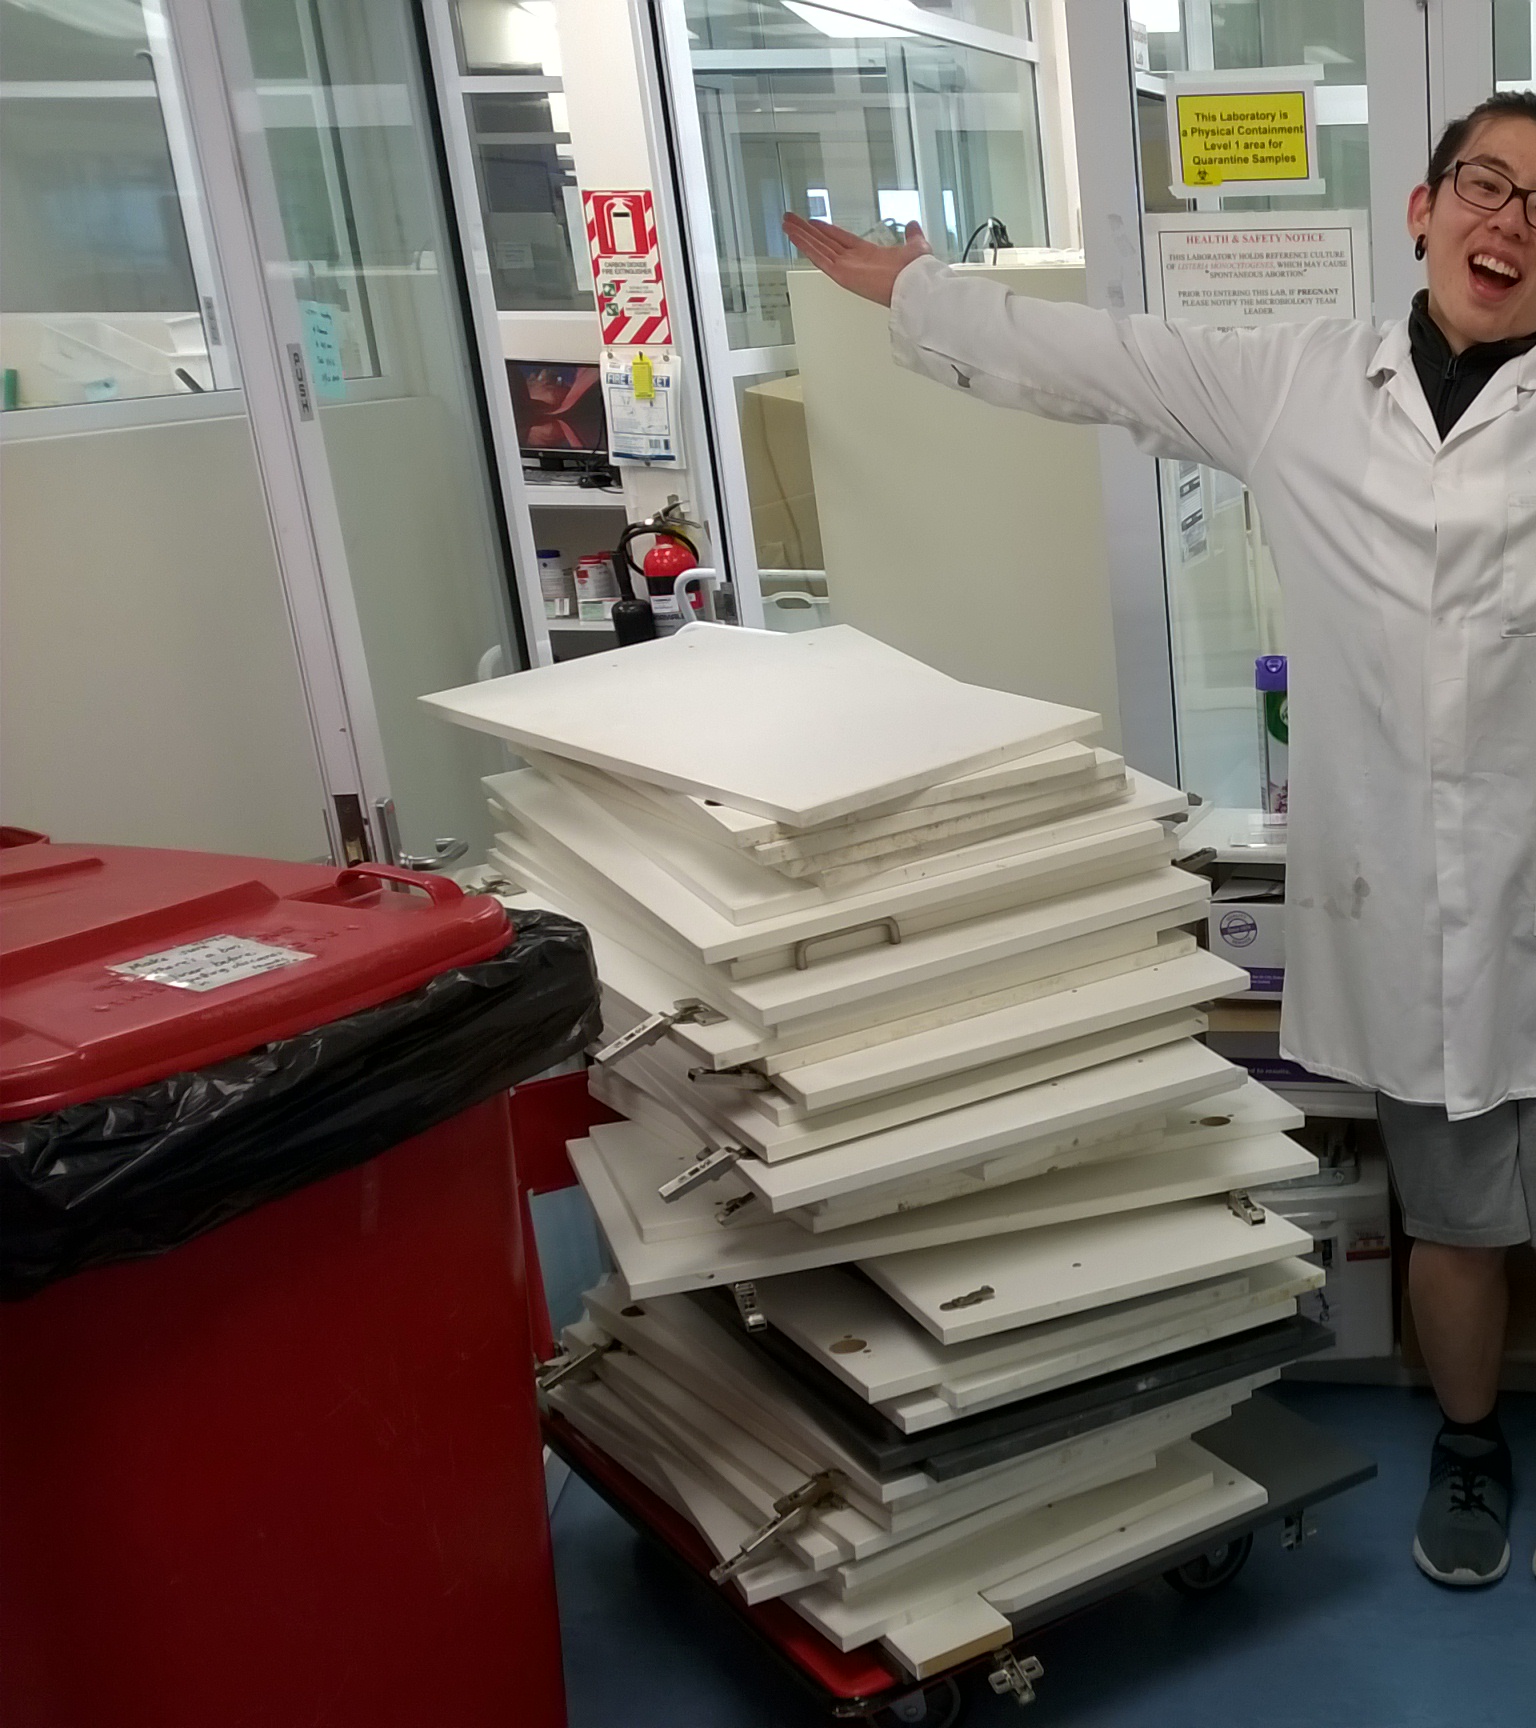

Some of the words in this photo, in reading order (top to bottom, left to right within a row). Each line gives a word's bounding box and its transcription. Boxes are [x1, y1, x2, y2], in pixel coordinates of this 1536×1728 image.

[1195, 112, 1217, 122] This
[1220, 111, 1276, 122] Laboratory
[1279, 110, 1288, 120] is
[1182, 129, 1187, 137] a
[1190, 126, 1234, 139] Physical
[1237, 125, 1304, 136] Containment
[1204, 141, 1231, 151] Level
[1235, 141, 1240, 150] 1
[1243, 141, 1265, 150] area
[1268, 139, 1283, 149] for
[1192, 155, 1249, 166] Quarantine
[1252, 154, 1296, 165] Samples
[1186, 235, 1229, 244] HEALTH
[1231, 234, 1239, 243] &
[1242, 233, 1281, 243] SAFETY
[1285, 233, 1325, 242] NOTICE
[1169, 253, 1185, 261] THIS
[1187, 253, 1236, 261] LABORATORY
[1239, 252, 1264, 260] HOLDS
[1266, 251, 1308, 259] REFERENCE
[1178, 262, 1208, 270] LISTERIA
[1304, 260, 1320, 268] MAY
[1178, 290, 1200, 298] PRIOR
[1214, 289, 1251, 297] ENTERING
[1256, 297, 1313, 305] MICROBIOLOGY
[293, 352, 309, 413] PUSH
[607, 374, 625, 385] FIRE
[628, 374, 669, 387] BKET
